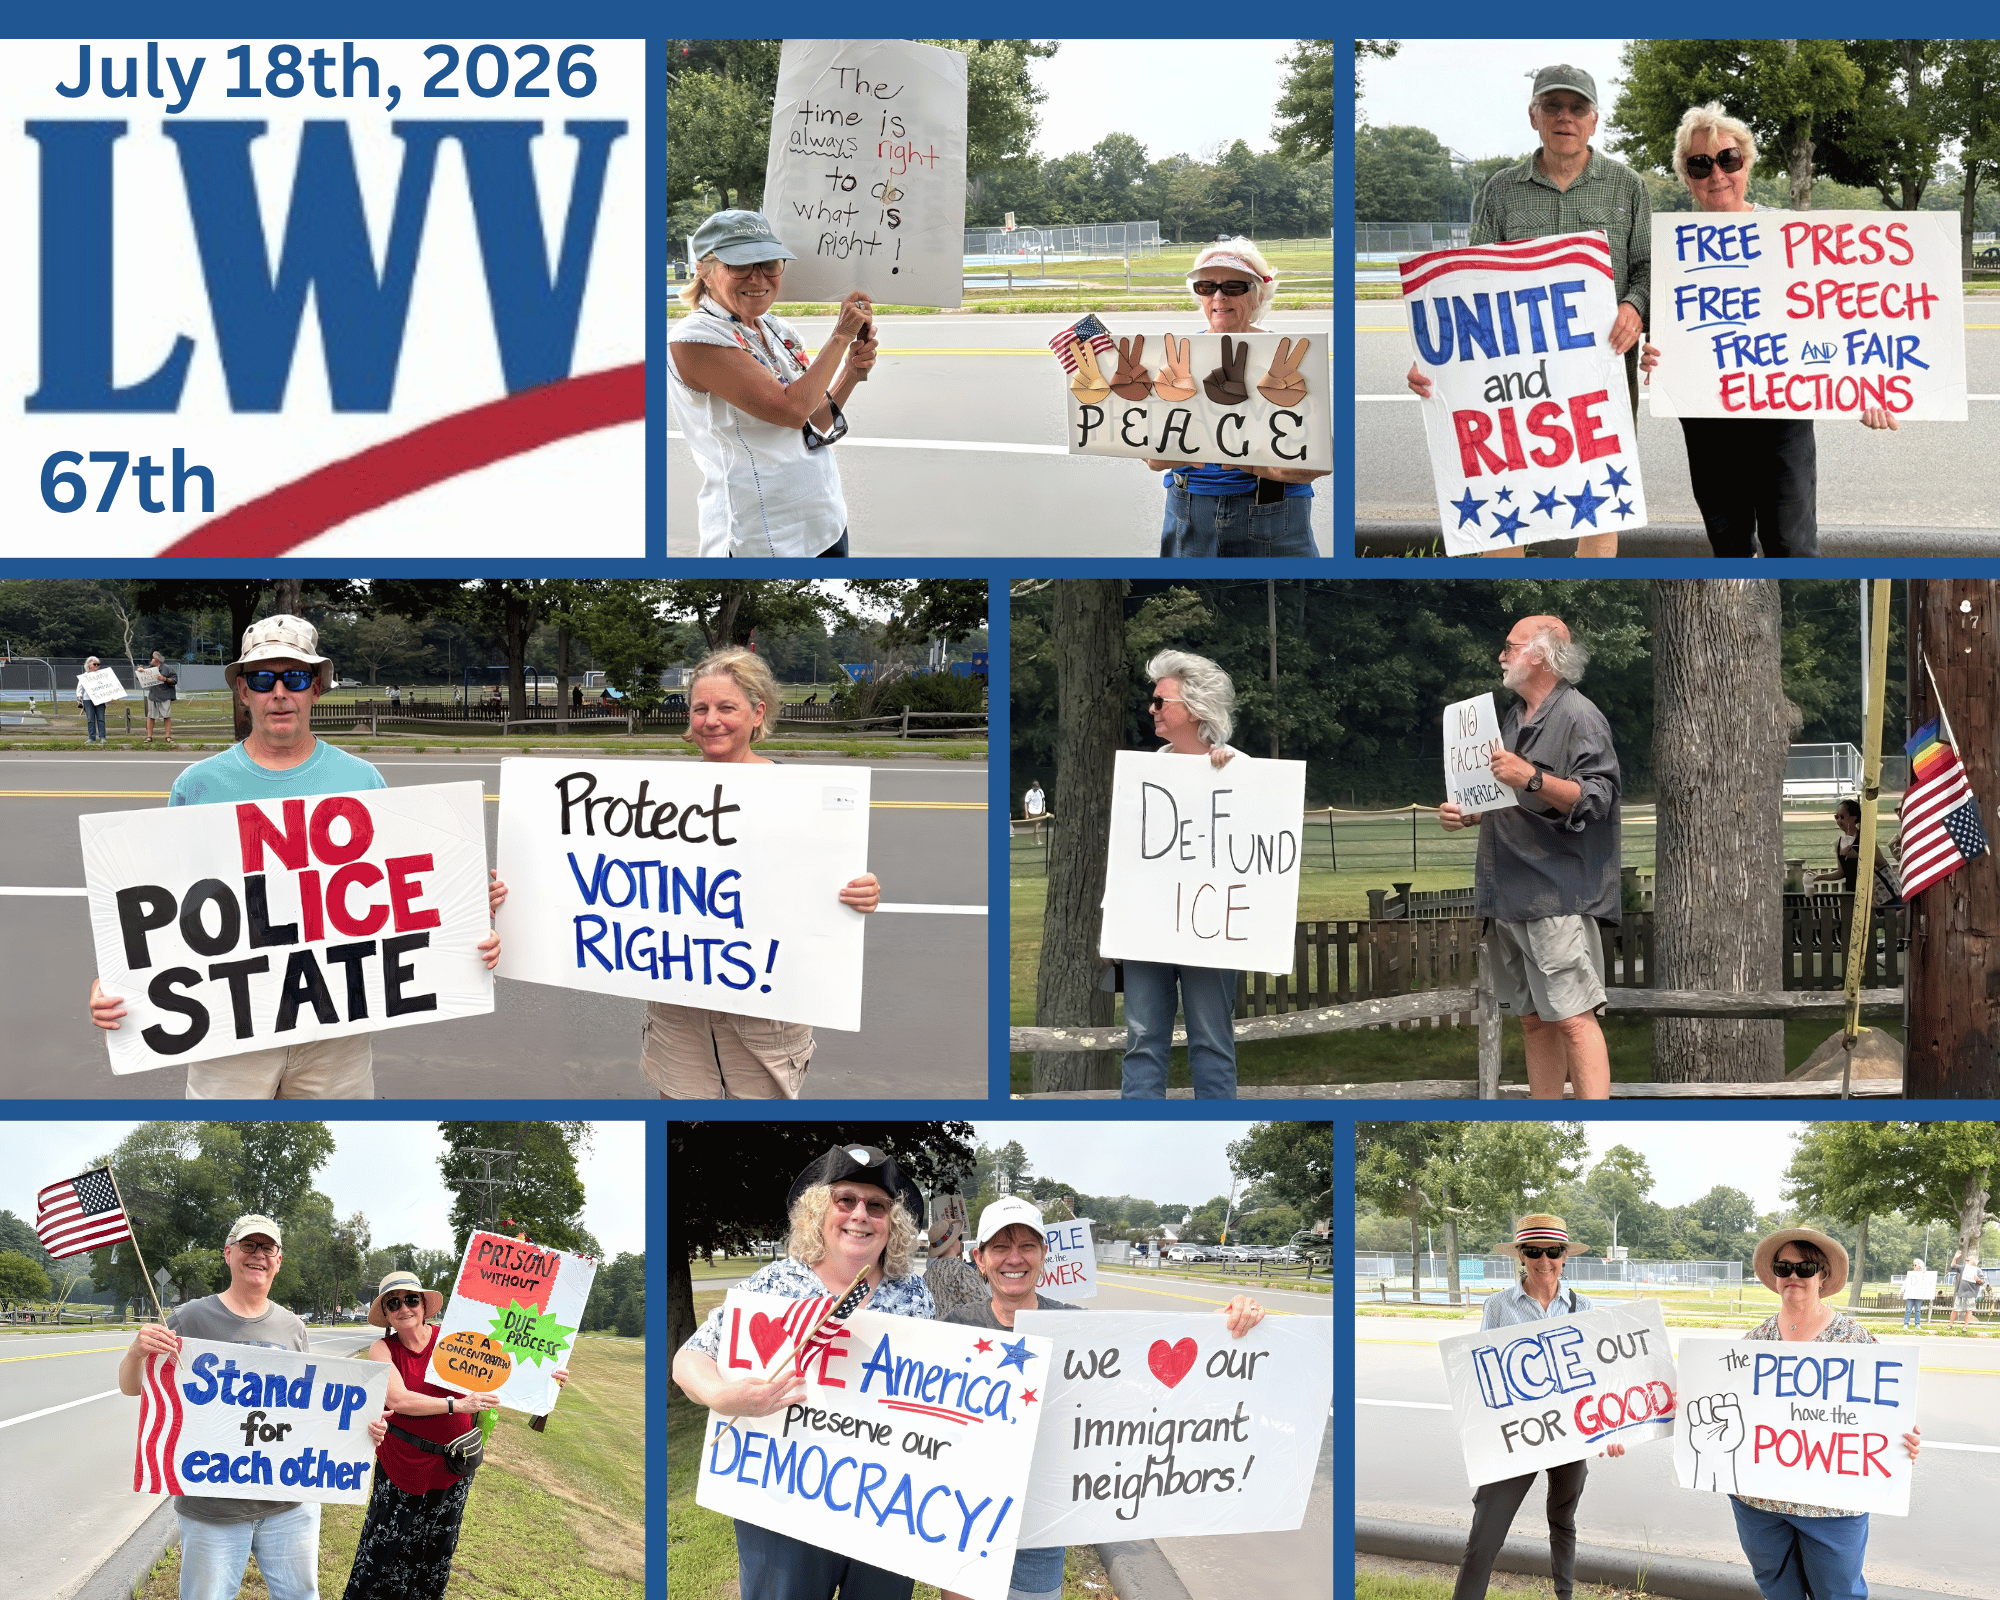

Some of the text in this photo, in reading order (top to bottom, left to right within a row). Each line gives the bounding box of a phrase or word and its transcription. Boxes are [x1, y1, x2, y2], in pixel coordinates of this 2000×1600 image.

[831, 67, 904, 99] The
[799, 100, 905, 138] time is
[791, 127, 940, 175] always right
[826, 166, 904, 201] to do
[793, 200, 860, 228] what
[880, 208, 901, 229] is
[1675, 221, 1915, 269] FREE PRESS
[1411, 280, 1596, 366] UNITE
[1675, 279, 1939, 322] FREE SPEECH
[1711, 328, 1930, 371] FREE AND FAIR
[1484, 359, 1552, 403] and
[1719, 371, 1914, 413] ELECTIONS
[1077, 404, 1307, 461] PEACE
[1453, 389, 1622, 479] RISE
[1460, 705, 1478, 739] NO
[555, 772, 740, 846] Protect
[1463, 782, 1505, 806] AMERICA
[236, 796, 375, 873] NO
[116, 853, 442, 970] POLICE
[567, 852, 744, 929] VOTING
[1176, 882, 1250, 941] ICE
[573, 914, 780, 993] RIGHTS!
[141, 932, 437, 1055] STATE
[478, 1241, 560, 1277] PRISON
[480, 1268, 539, 1292] WITHOUT
[455, 1332, 491, 1350] IS A
[504, 1311, 537, 1336] DUE
[506, 1330, 561, 1356] PROCESS
[438, 1341, 511, 1369] CONCENTRATION
[449, 1358, 494, 1382] CAMP!
[859, 1333, 1017, 1425] America,
[1063, 1348, 1270, 1380] we our
[1471, 1325, 1650, 1409] ICE OUT
[1719, 1348, 1903, 1408] the PEOPLE
[183, 1353, 367, 1430] Stand up
[1791, 1402, 1858, 1425] have the
[240, 1410, 292, 1446] for
[783, 1404, 952, 1460] preserve our
[1073, 1401, 1250, 1466] immigrant
[1500, 1380, 1675, 1453] FOR GOOD
[181, 1447, 371, 1490] each other
[1754, 1424, 1892, 1478] POWER
[710, 1421, 1014, 1558] DEMOCRACY!
[1072, 1454, 1255, 1520] neighbors!
